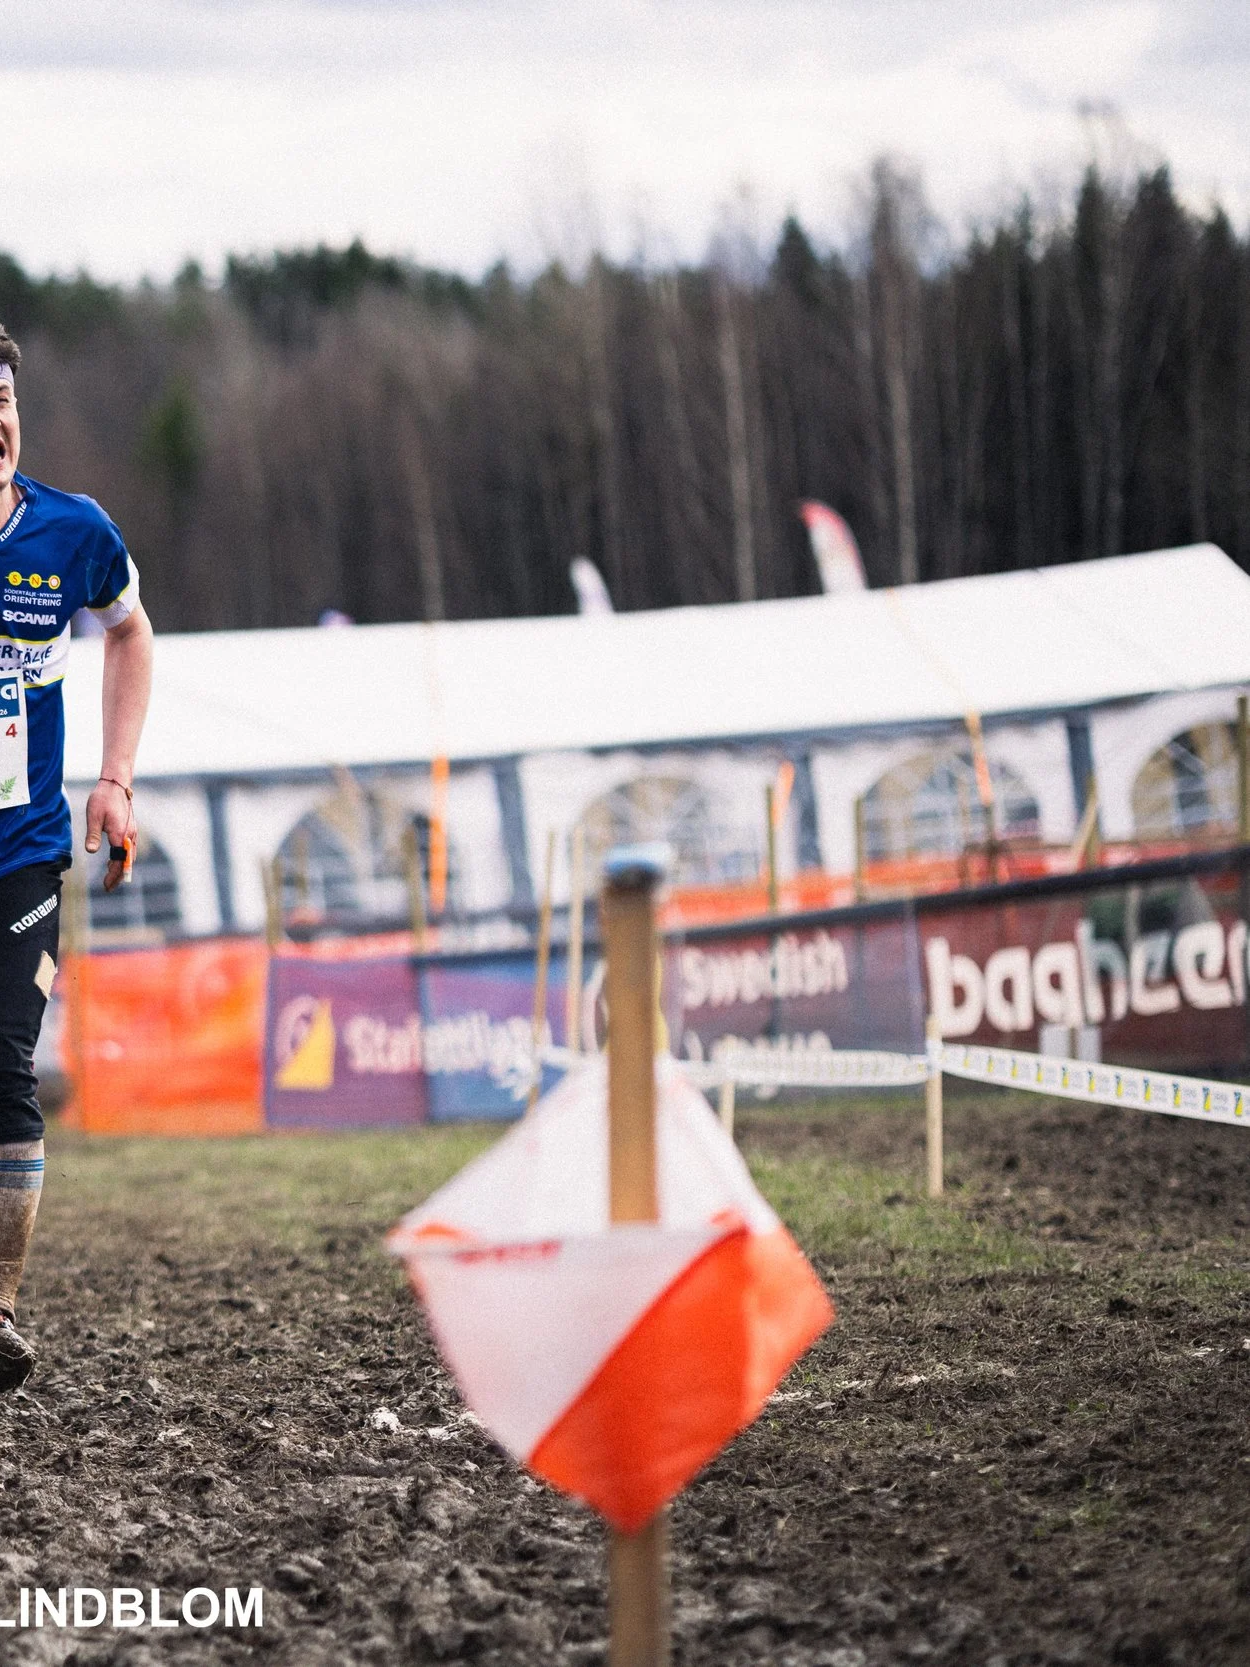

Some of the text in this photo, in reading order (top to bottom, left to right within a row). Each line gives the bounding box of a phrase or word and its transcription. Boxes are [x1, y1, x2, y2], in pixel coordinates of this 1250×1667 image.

[3, 595, 62, 607] ORIENTERING
[2, 609, 57, 625] SCANIA
[5, 723, 18, 738] 4
[10, 894, 58, 933] noname
[681, 930, 848, 1009] Swedish
